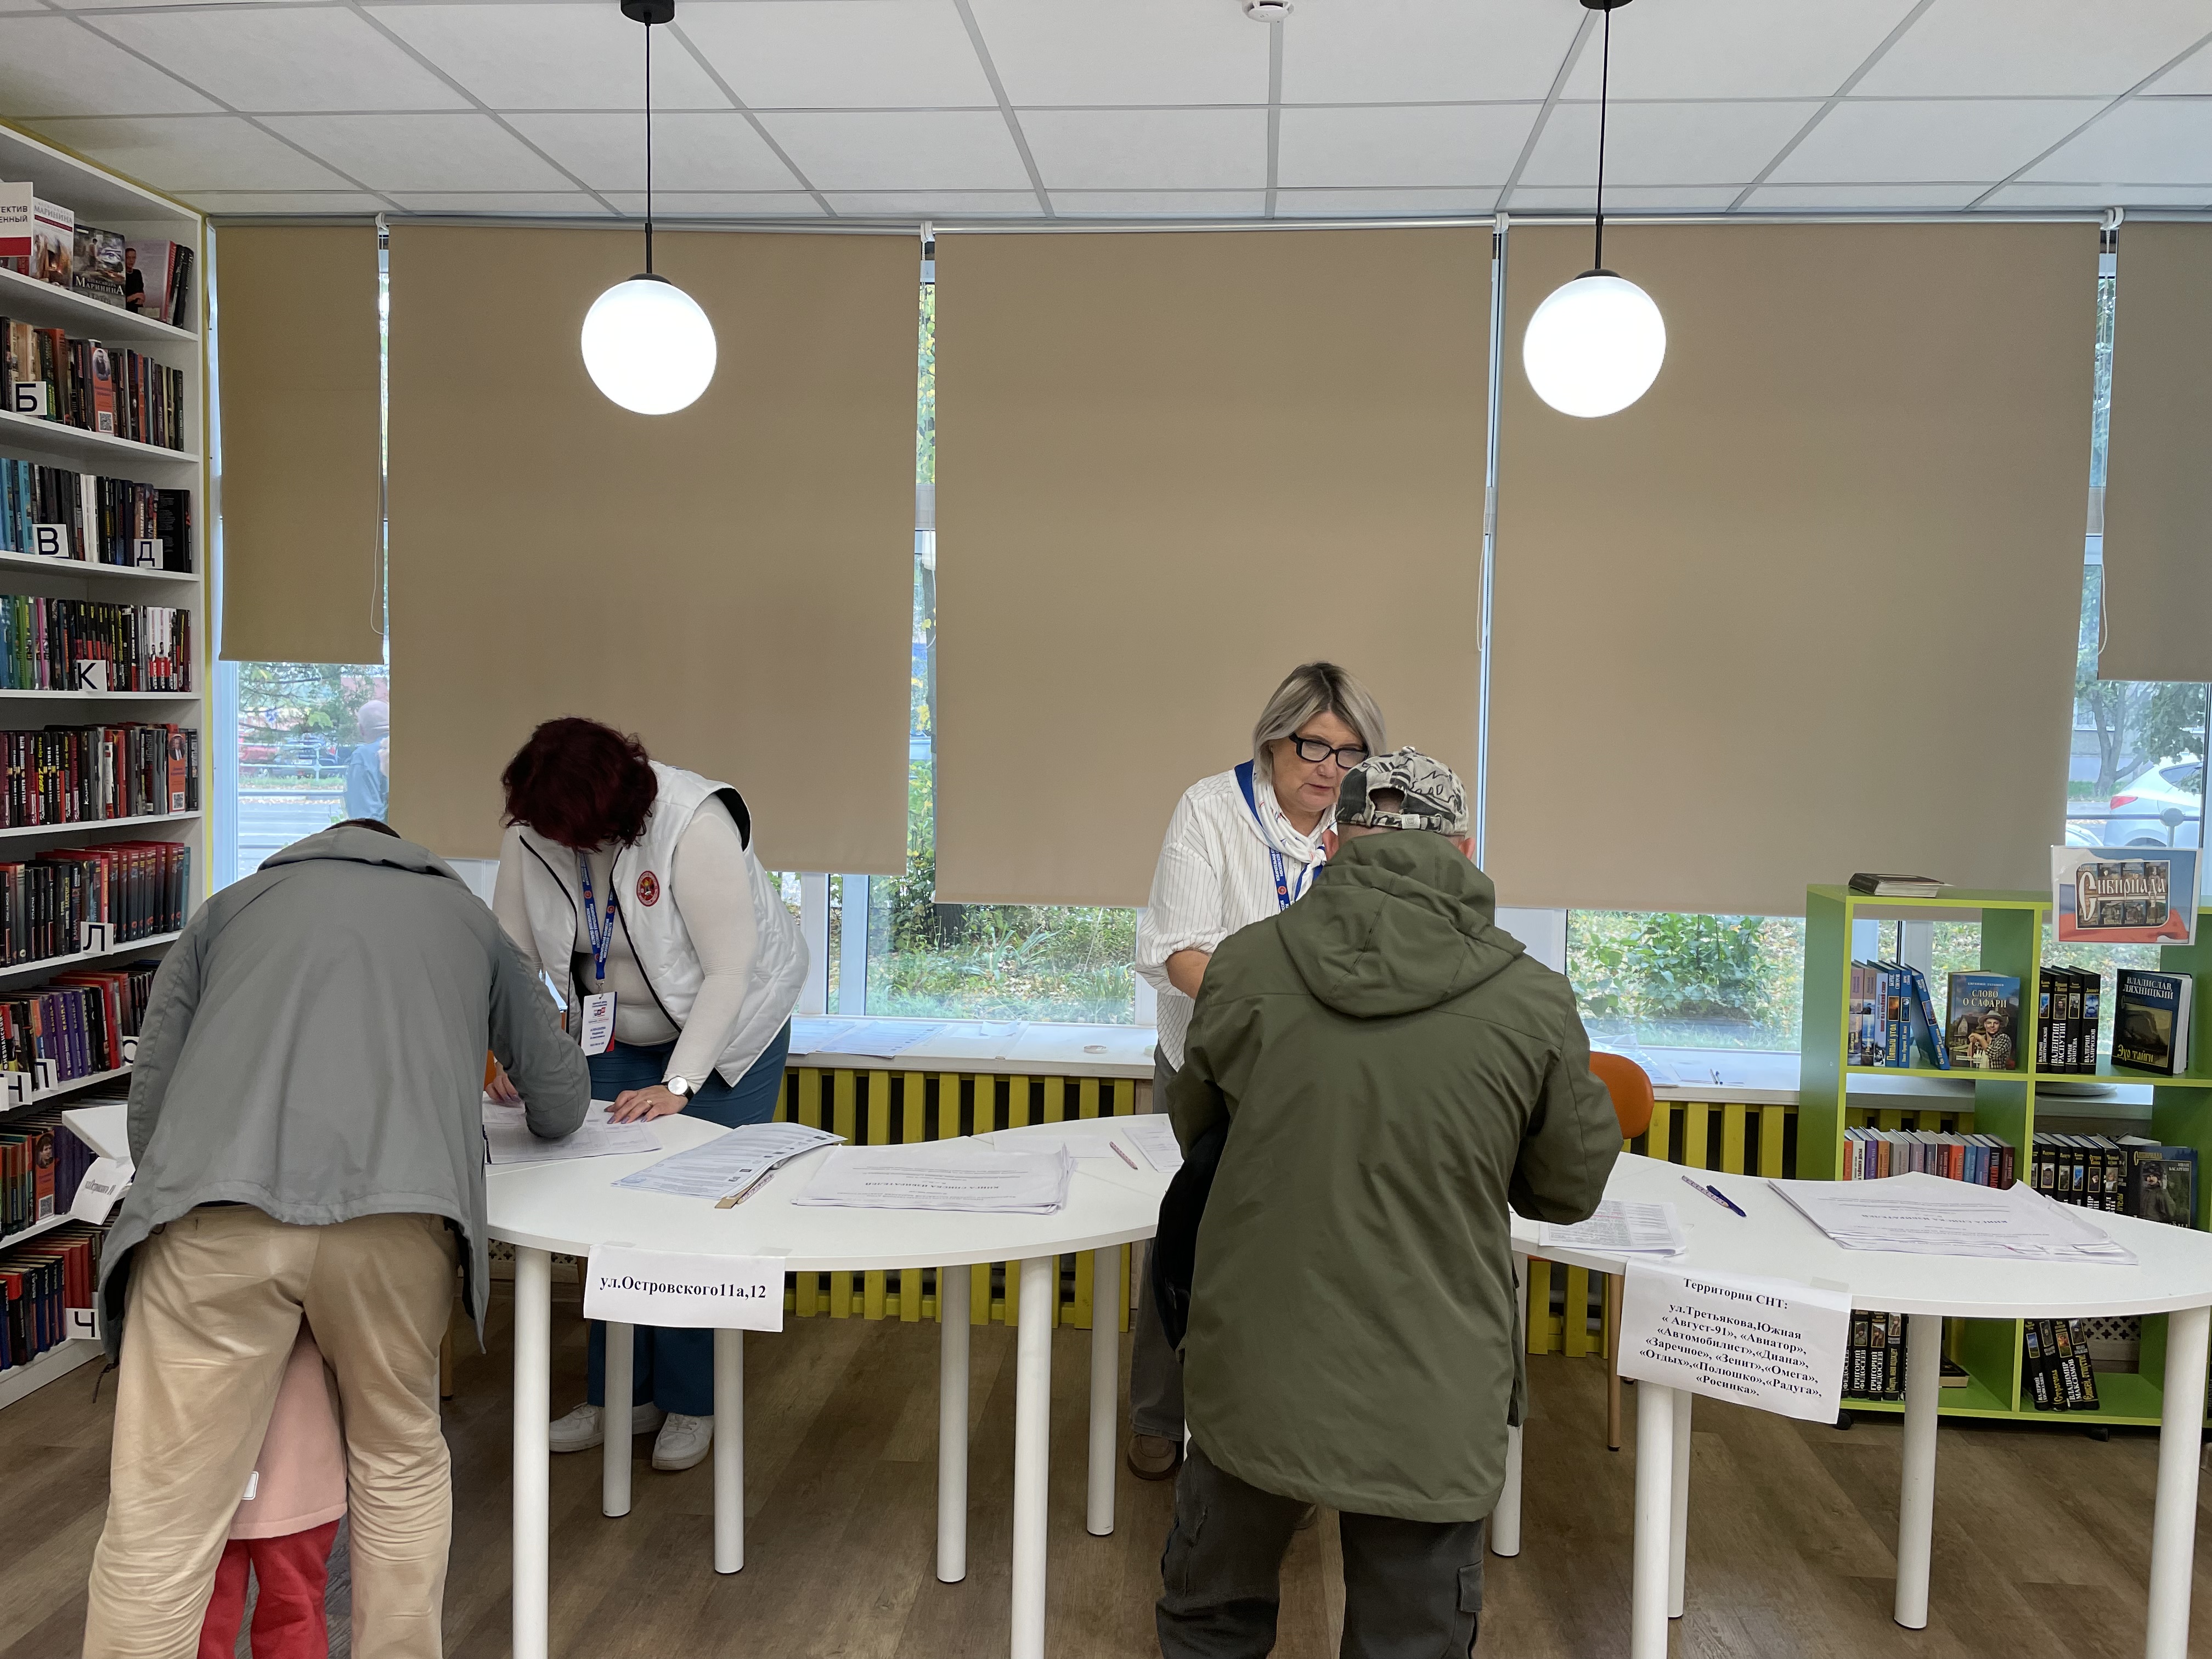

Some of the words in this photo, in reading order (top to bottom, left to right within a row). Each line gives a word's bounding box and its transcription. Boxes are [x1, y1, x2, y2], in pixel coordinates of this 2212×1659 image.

[34, 205, 72, 224] МАРИНИНА
[15, 382, 37, 413] Б
[36, 527, 59, 556] В
[137, 541, 155, 567] Д
[77, 662, 98, 690] К
[83, 924, 105, 952] Л
[1972, 989, 1999, 998] СЛОВО
[2122, 984, 2174, 1000] ЛЯХНИЦКИЙ
[2126, 977, 2172, 991] ВЛАДИСЛАВ
[1962, 997, 1969, 1006] О
[1971, 997, 2007, 1008] САФАРИ
[1889, 1024, 1898, 1037] угол
[2051, 1023, 2059, 1064] ВАЛЕНТИН
[2058, 1023, 2066, 1064] РАСПУТИН
[1886, 1039, 1897, 1060] Пятый
[2117, 1044, 2131, 1063] Эхо
[2132, 1048, 2154, 1063] тайги
[600, 1276, 766, 1300] ул.Островского11а,12
[1683, 1277, 1752, 1302] Территории
[1756, 1295, 1788, 1310] СНТ:
[74, 1311, 95, 1338] Ч
[1669, 1303, 1802, 1340] ул.Третьякова,Южная
[1645, 1336, 1712, 1360] «Заречное»,
[1671, 1316, 1737, 1340] Август-91»,
[1740, 1333, 1807, 1355] «Авиатор»,
[1696, 1375, 1759, 1397] «Росинка».
[2062, 1362, 2076, 1400] ВЛАДИМИР
[2068, 1358, 2082, 1400] МАКСИМОВ
